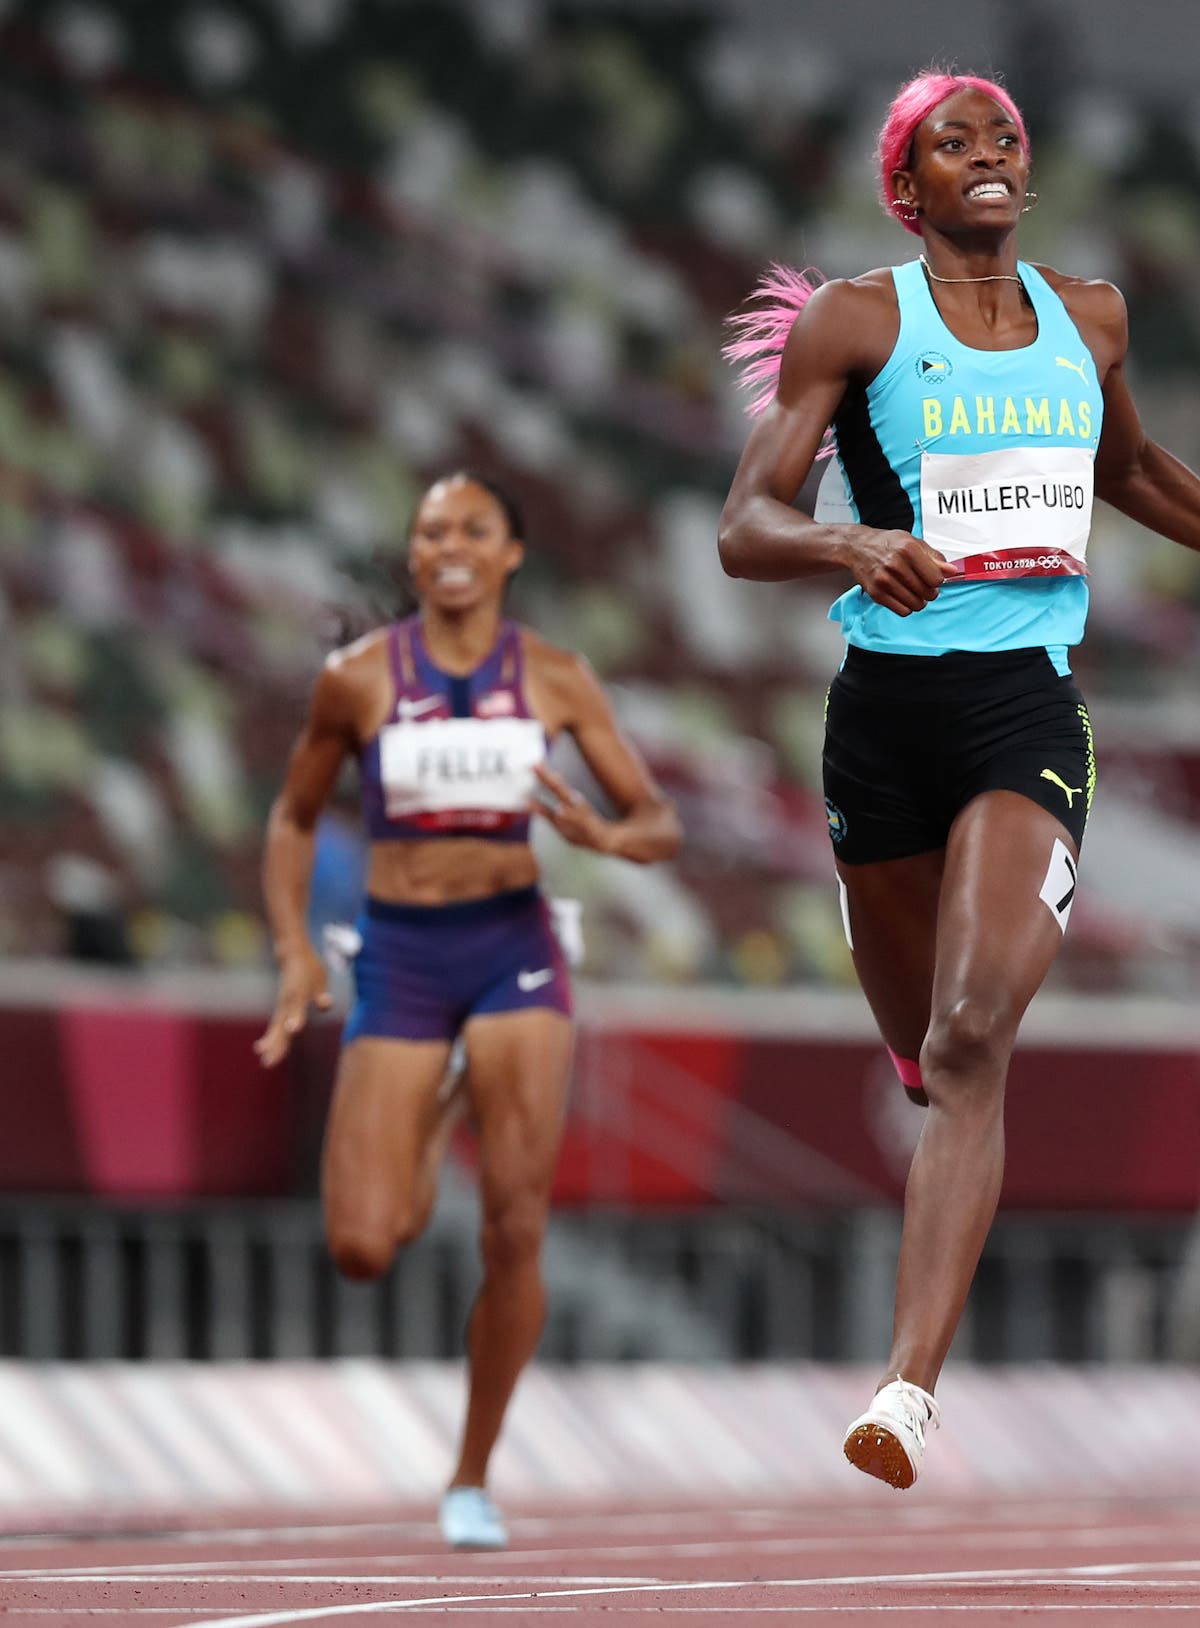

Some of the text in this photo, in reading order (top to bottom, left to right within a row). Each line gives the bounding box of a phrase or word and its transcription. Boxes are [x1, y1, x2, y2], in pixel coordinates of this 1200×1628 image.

[922, 396, 1093, 439] BAHAMAS
[937, 484, 1085, 515] MILLER-UIBO
[983, 559, 1036, 571] TOKYO 2020
[416, 745, 512, 785] FELIX
